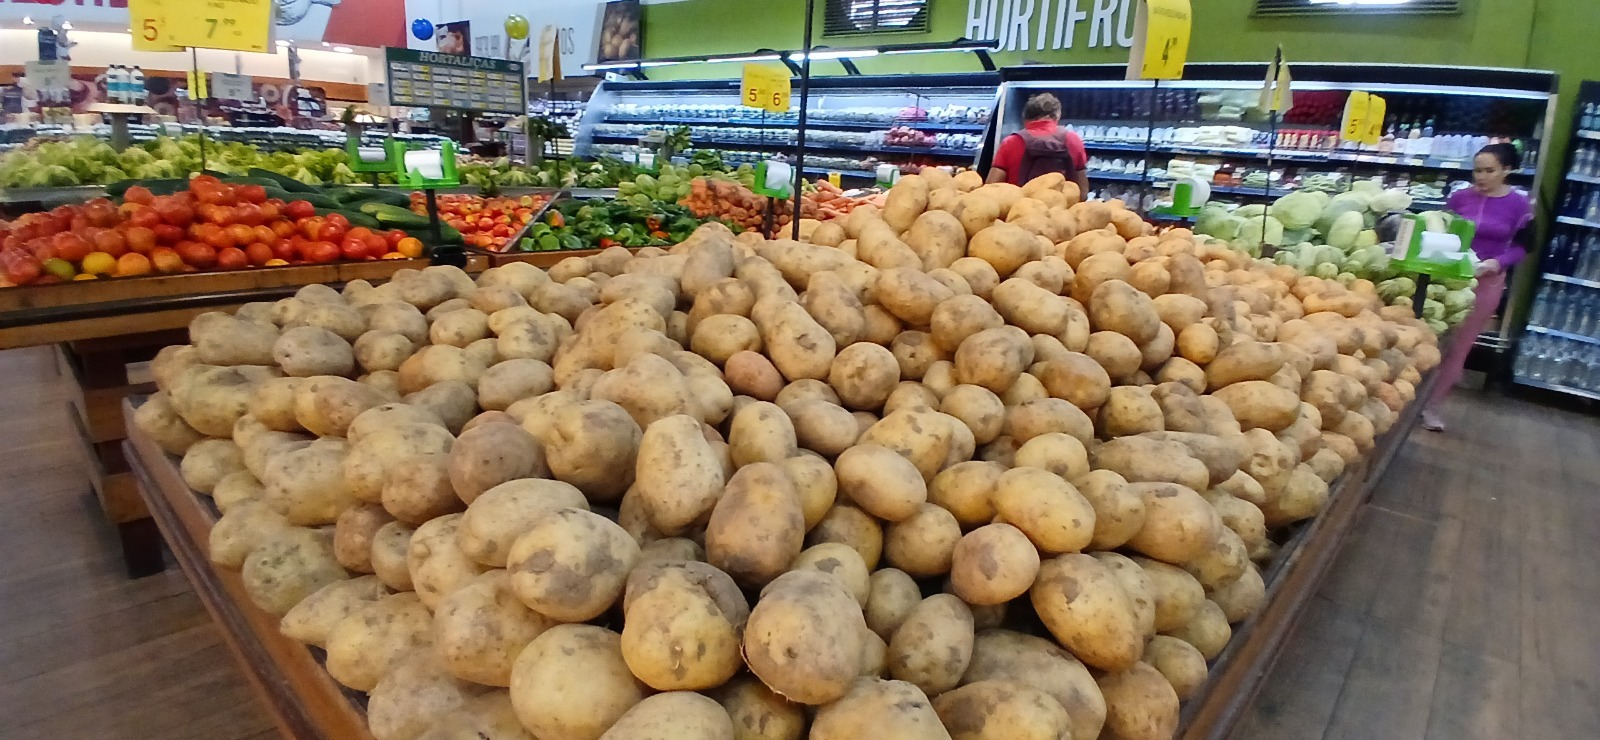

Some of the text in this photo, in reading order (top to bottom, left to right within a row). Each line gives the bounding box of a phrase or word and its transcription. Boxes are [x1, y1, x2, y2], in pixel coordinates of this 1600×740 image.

[205, 18, 218, 38] 7
[419, 51, 496, 70] HORTALIÇAS
[749, 88, 757, 102] 5
[772, 92, 781, 106] 6
